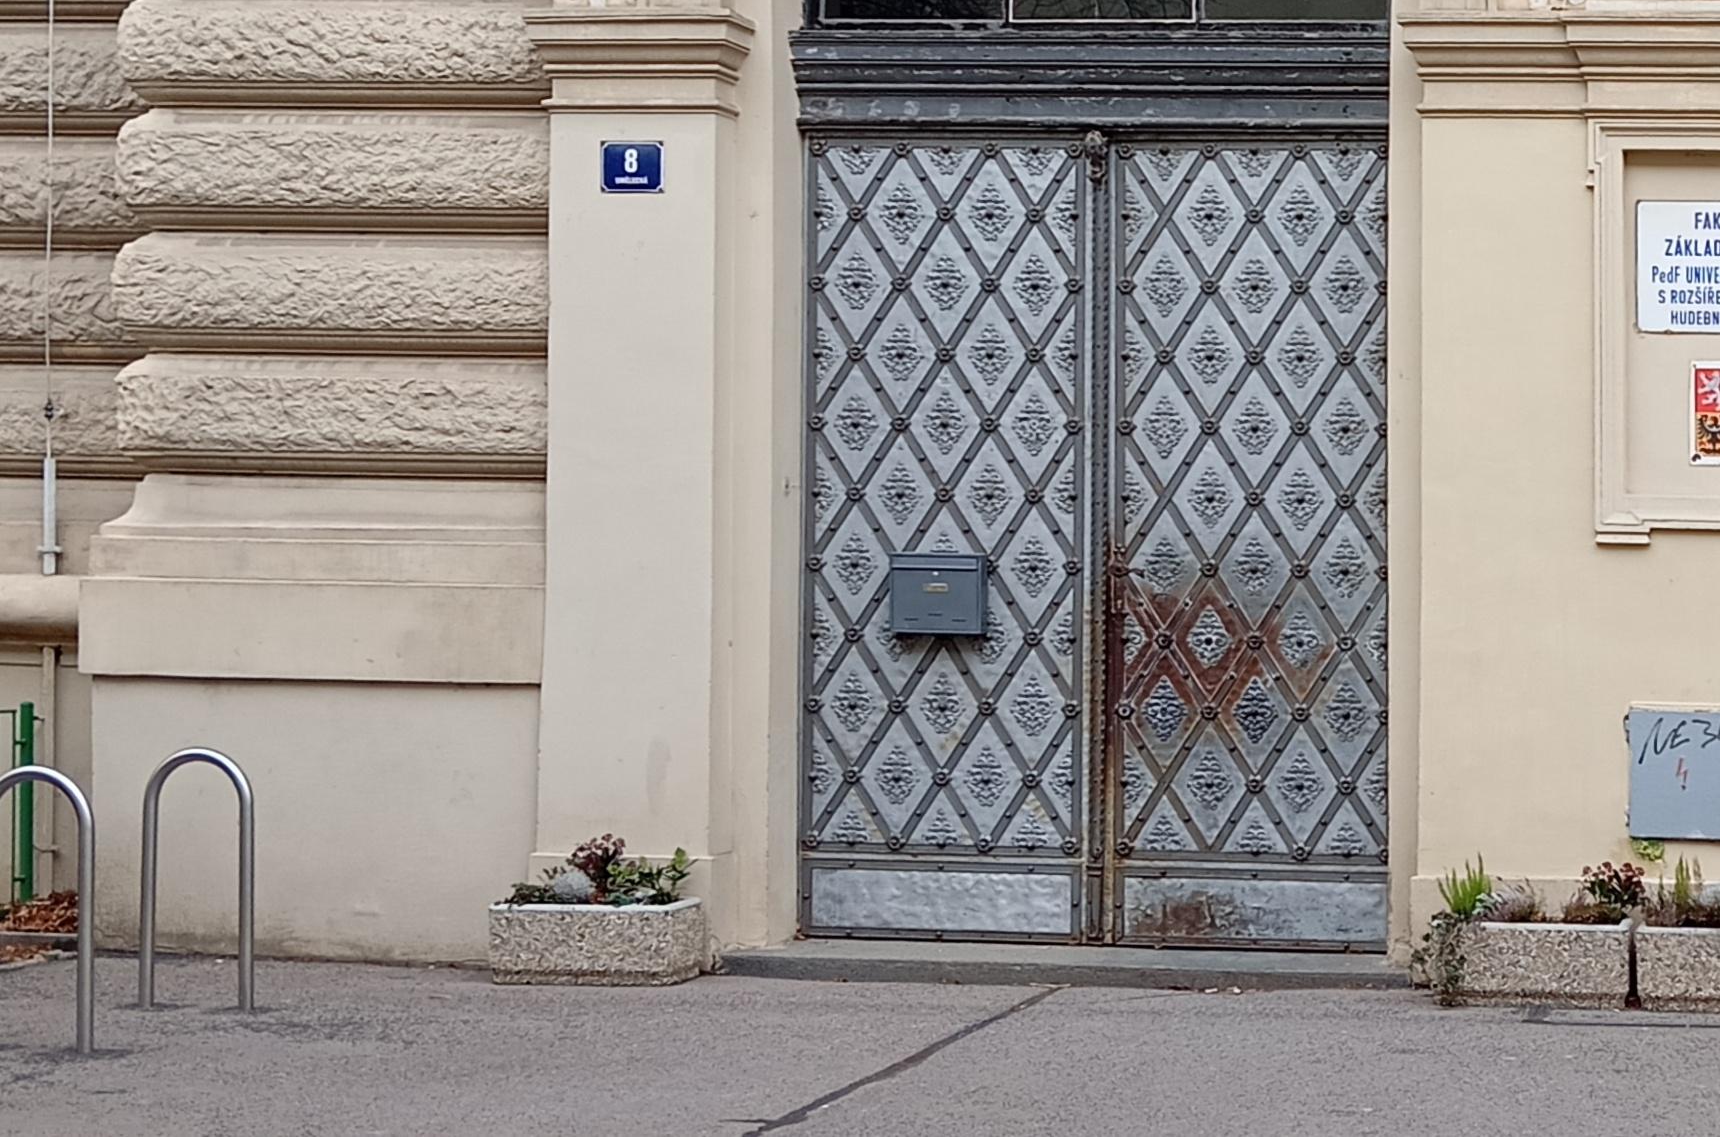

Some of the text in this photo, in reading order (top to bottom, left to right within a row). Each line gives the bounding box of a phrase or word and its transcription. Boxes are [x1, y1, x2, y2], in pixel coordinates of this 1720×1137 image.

[624, 148, 639, 174] 8
[1651, 265, 1681, 284] PedF
[1658, 289, 1667, 304] S
